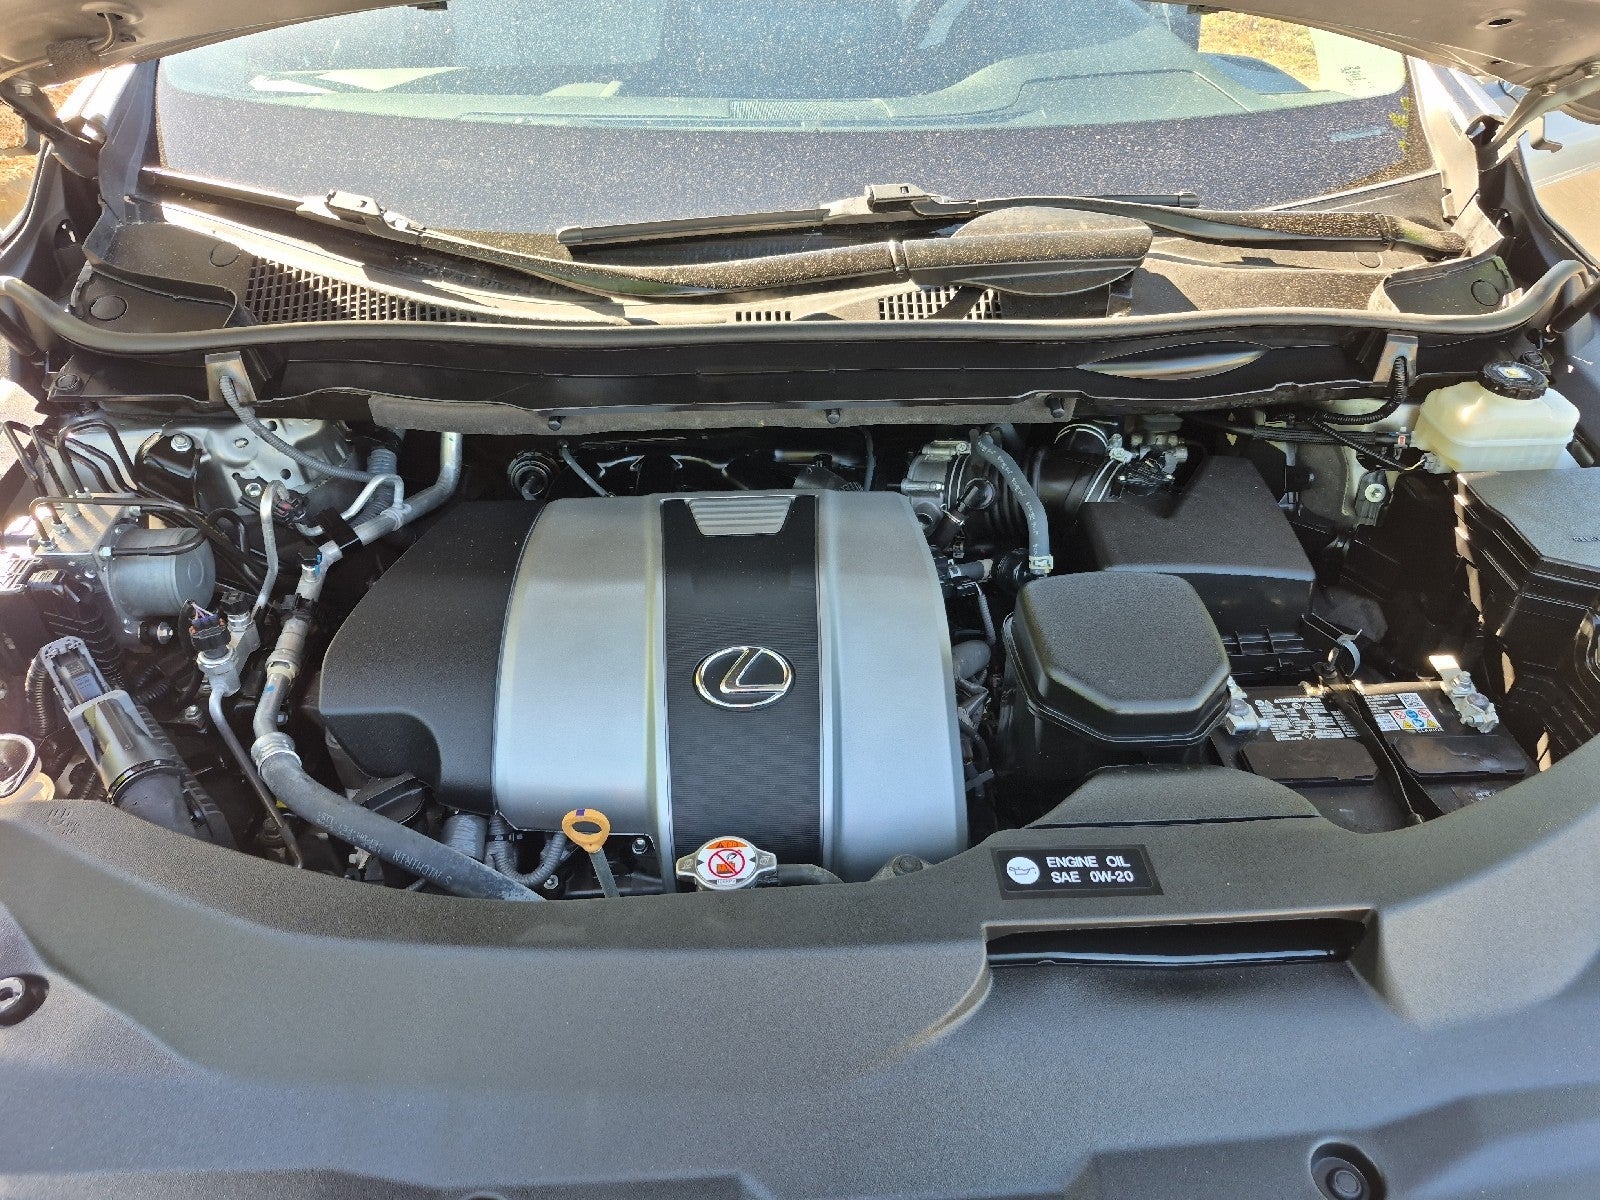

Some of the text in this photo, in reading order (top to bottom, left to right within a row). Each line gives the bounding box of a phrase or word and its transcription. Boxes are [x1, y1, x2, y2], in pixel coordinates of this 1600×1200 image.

[392, 850, 443, 881] NICHIRIN
[1045, 855, 1131, 868] ENGINE OIL
[1051, 870, 1135, 884] SAE 0W-20
